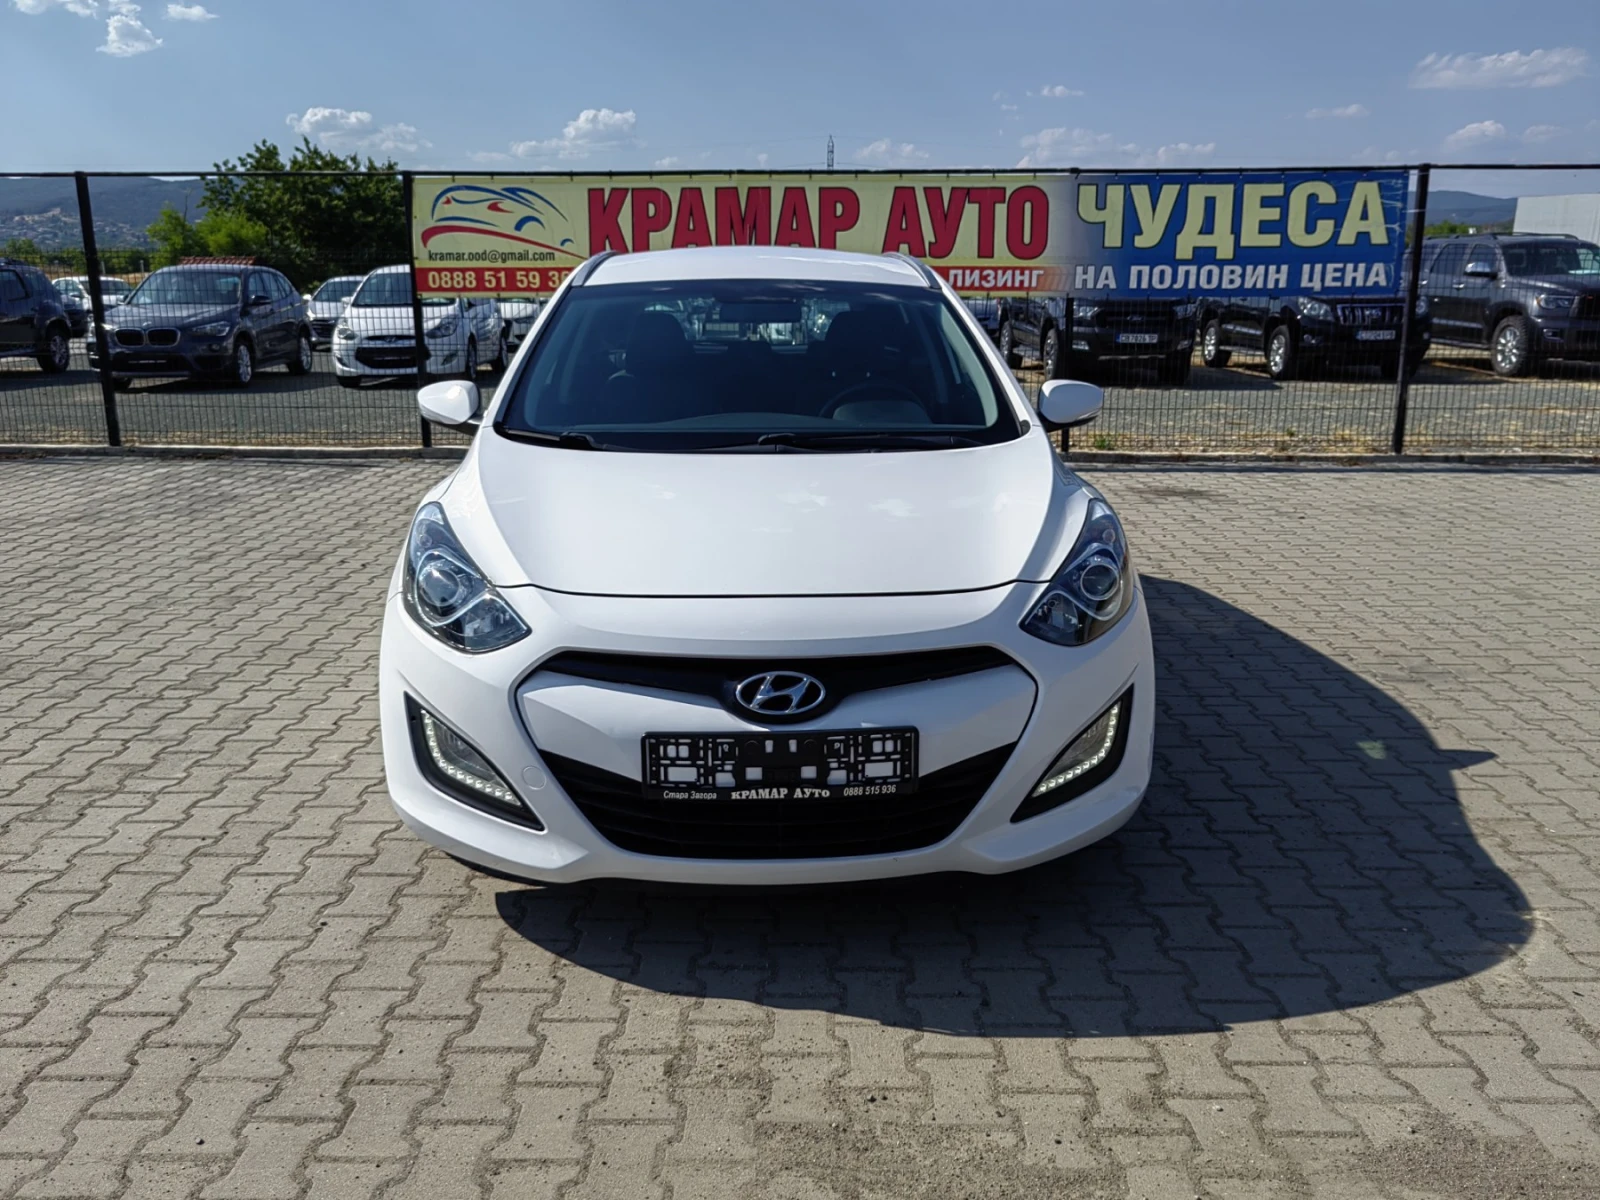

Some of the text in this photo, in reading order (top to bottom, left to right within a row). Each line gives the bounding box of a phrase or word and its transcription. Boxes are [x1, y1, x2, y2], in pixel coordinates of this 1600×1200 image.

[587, 185, 1049, 260] КРАМАР АУТО
[1077, 180, 1390, 260] ЧУДЕСА
[428, 250, 555, 263] kramar.ood@gmail.com
[428, 271, 477, 288] 0888
[484, 271, 506, 288] 51
[516, 271, 541, 288] 59
[949, 269, 1044, 288] ЛИЗИНГ
[1074, 262, 1387, 291] НА ПОЛОВИН ЦЕНА
[663, 790, 689, 800] Стара
[690, 790, 717, 800] Загора
[731, 787, 788, 799] КРАМАР
[843, 784, 896, 796] 0888 515 936
